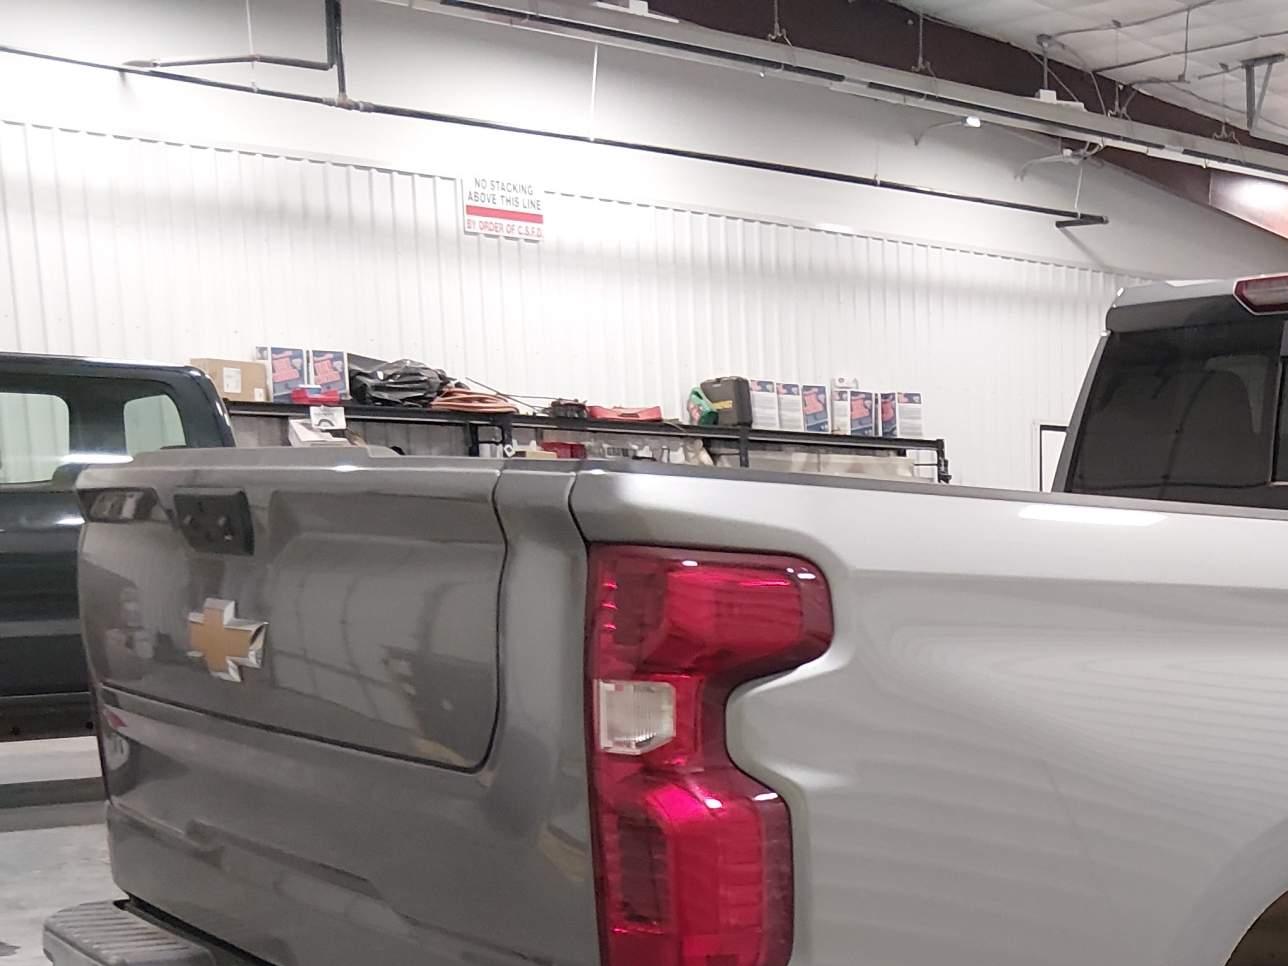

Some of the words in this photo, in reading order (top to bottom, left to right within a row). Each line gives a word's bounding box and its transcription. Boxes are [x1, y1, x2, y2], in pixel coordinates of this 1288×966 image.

[474, 177, 487, 190] NO
[490, 179, 534, 196] STACKING
[467, 191, 497, 205] ABOVE
[500, 194, 520, 208] THIS
[522, 199, 542, 211] LINE
[479, 219, 504, 234] ORDER
[506, 223, 516, 235] OF
